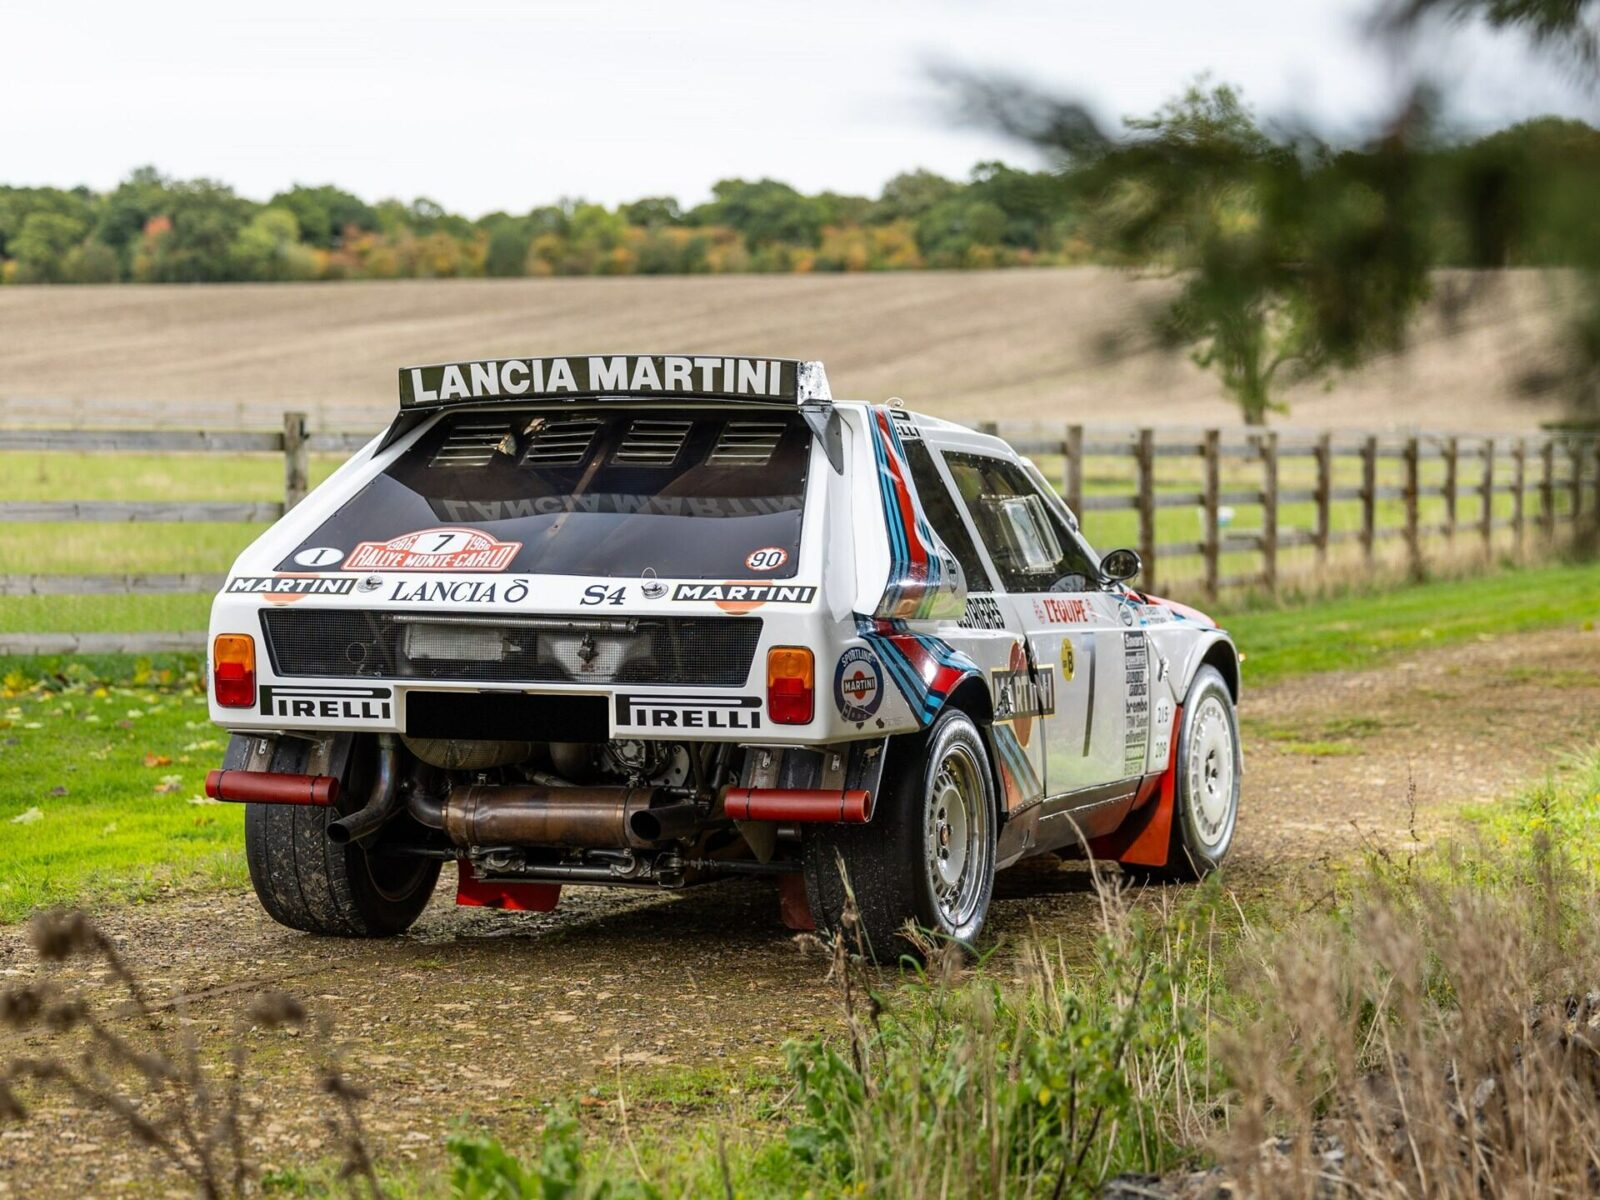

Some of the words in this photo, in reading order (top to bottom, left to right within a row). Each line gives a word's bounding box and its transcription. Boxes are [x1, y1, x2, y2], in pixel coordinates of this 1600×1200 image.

[411, 357, 578, 402] LANCIA
[588, 357, 782, 396] MARTINI
[432, 534, 456, 552] 7
[351, 545, 405, 567] RALLYE
[401, 546, 512, 568] MONTE-CARLO
[750, 551, 782, 567] 90
[230, 577, 354, 594] MARTINI
[388, 580, 497, 602] LANCIA
[580, 585, 627, 606] S4
[676, 583, 813, 602] MARTINI
[842, 648, 872, 668] SPORTLINE
[844, 678, 876, 691] MARTINI
[259, 685, 392, 719] PIRELLI
[615, 694, 763, 729] PIRELLI
